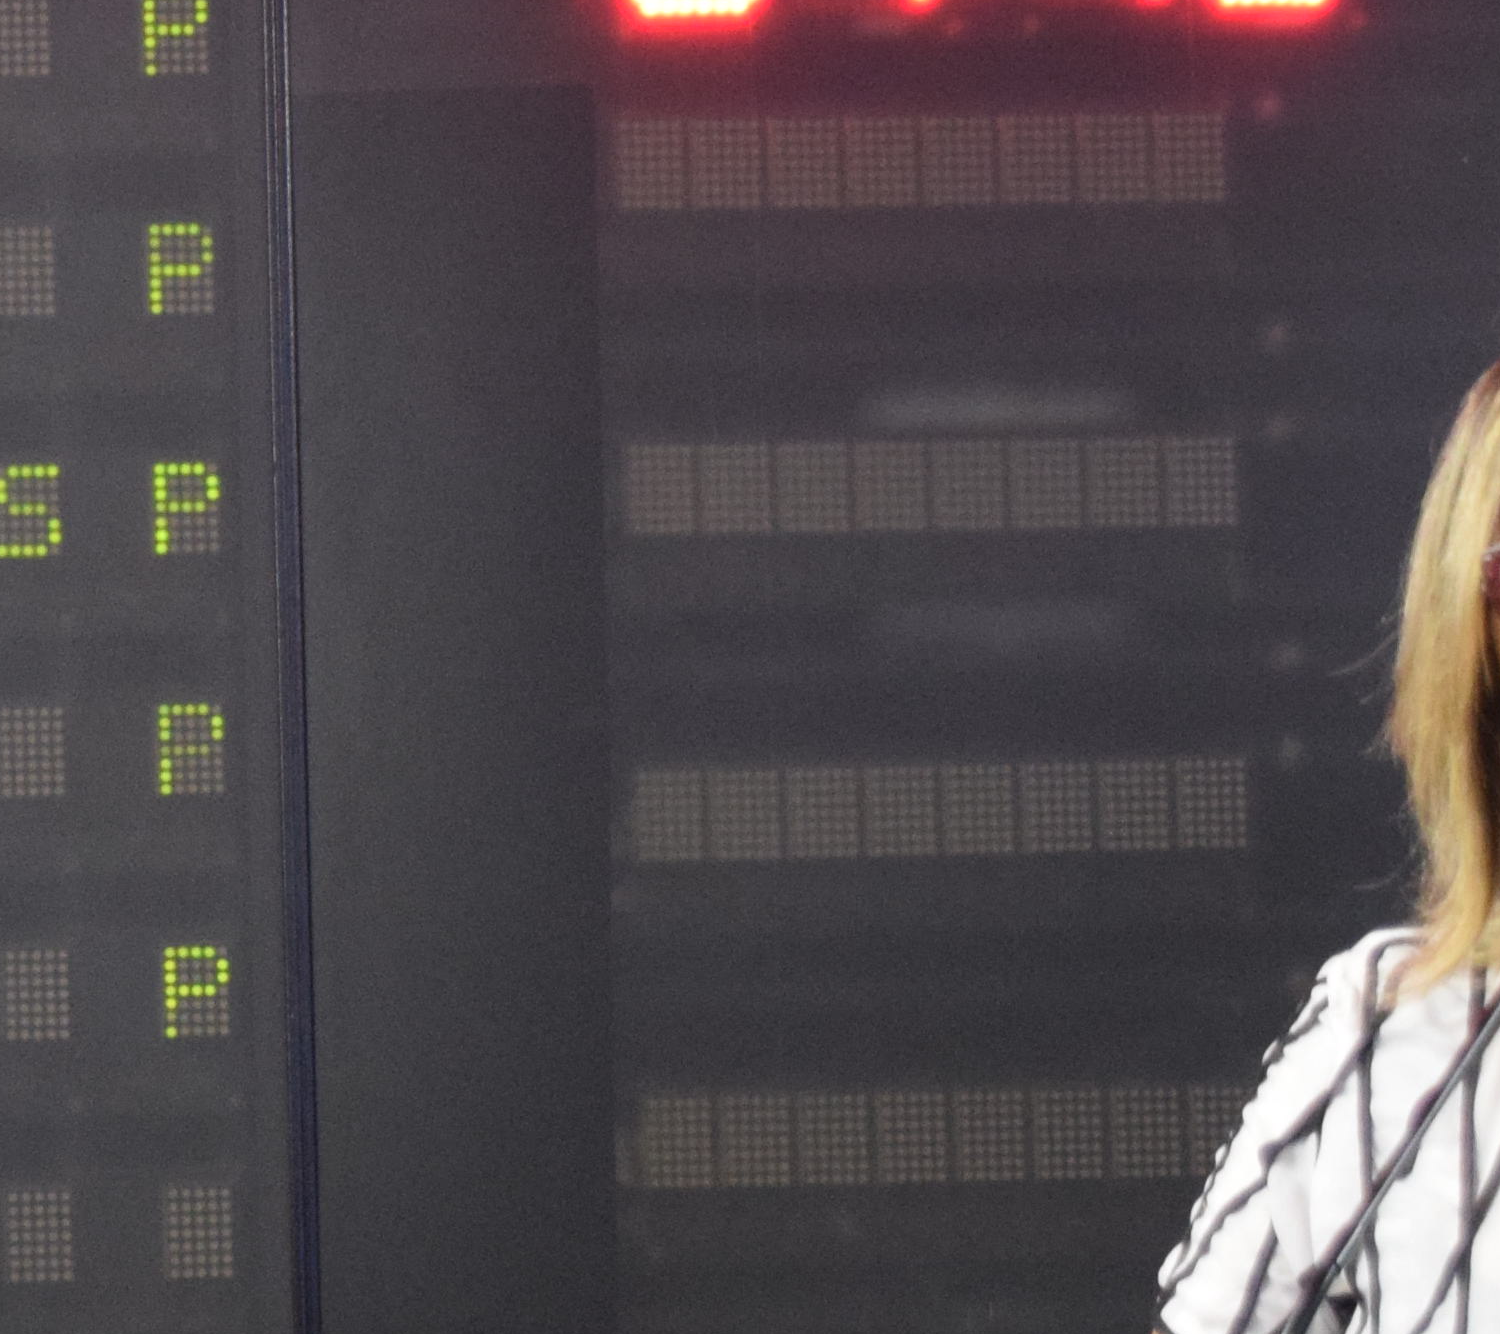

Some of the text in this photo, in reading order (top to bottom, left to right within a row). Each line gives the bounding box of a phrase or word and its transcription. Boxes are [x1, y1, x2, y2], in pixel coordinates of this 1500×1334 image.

[148, 222, 213, 314] P
[152, 462, 221, 555] P
[157, 703, 225, 796] P
[163, 945, 230, 1038] P
